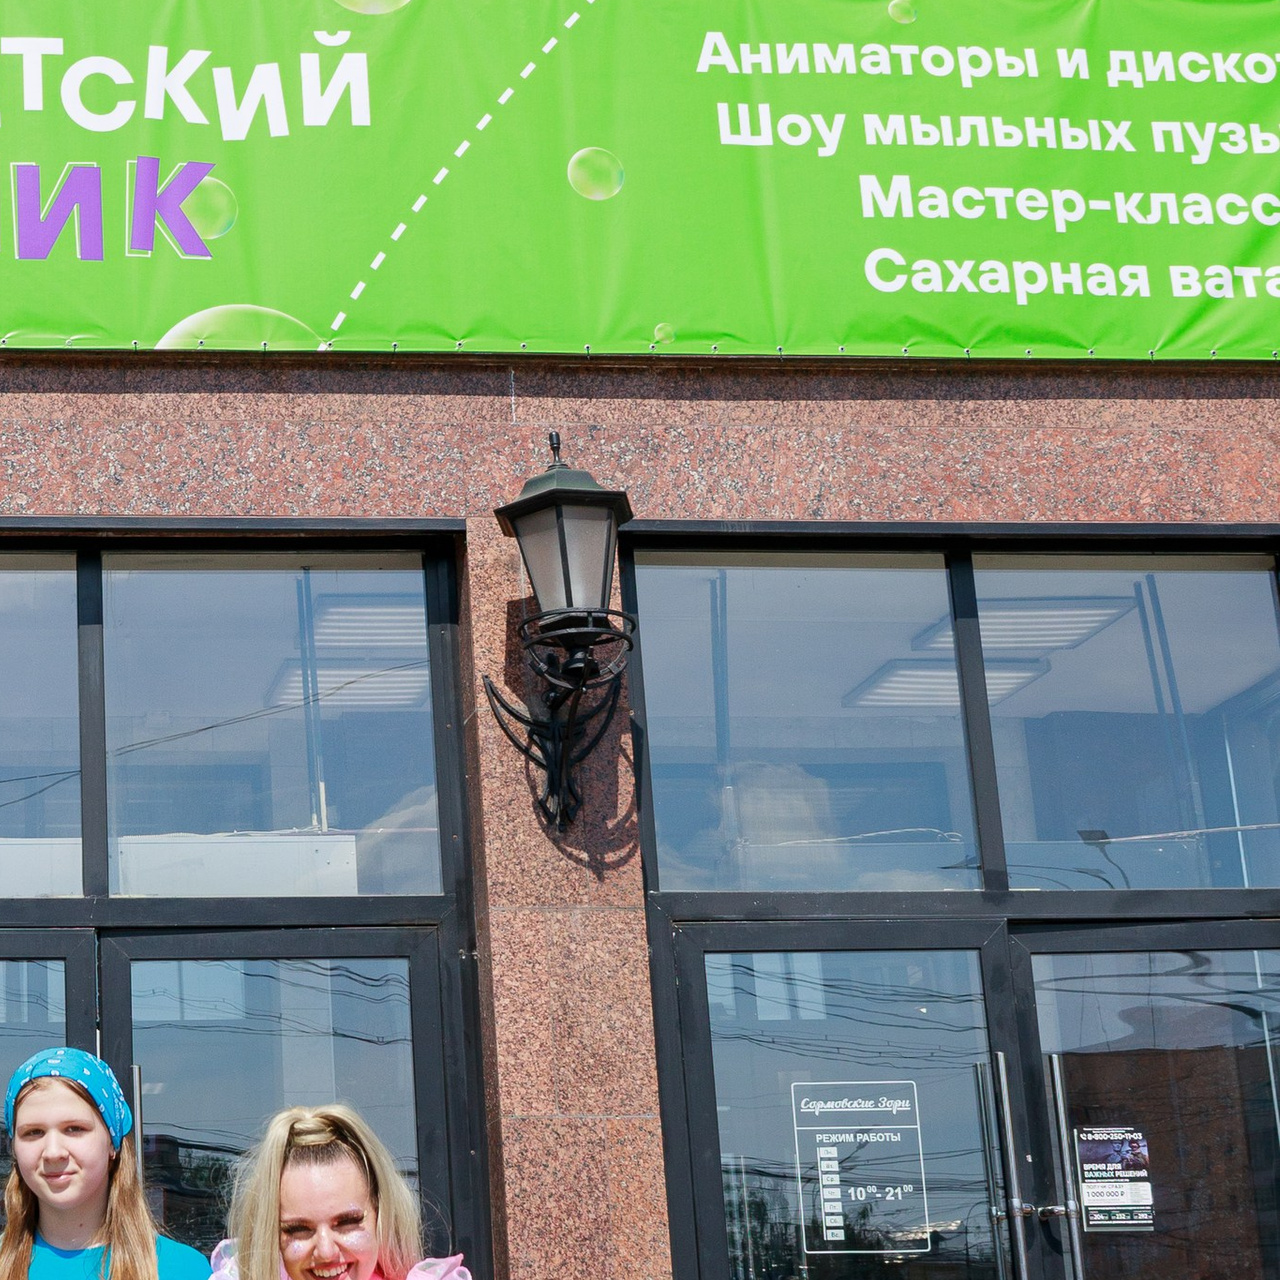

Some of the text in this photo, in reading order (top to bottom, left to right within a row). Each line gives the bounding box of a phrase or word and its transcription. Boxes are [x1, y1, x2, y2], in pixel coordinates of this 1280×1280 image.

[695, 31, 1280, 89] Аниматоры и диско
[716, 102, 846, 157] Шоу
[863, 111, 1137, 153] мыльных
[863, 248, 1151, 305] Сахарная
[800, 1097, 911, 1116] Сормовские Зори
[816, 1132, 901, 1143] РЕЖИМ РАБОТЫ
